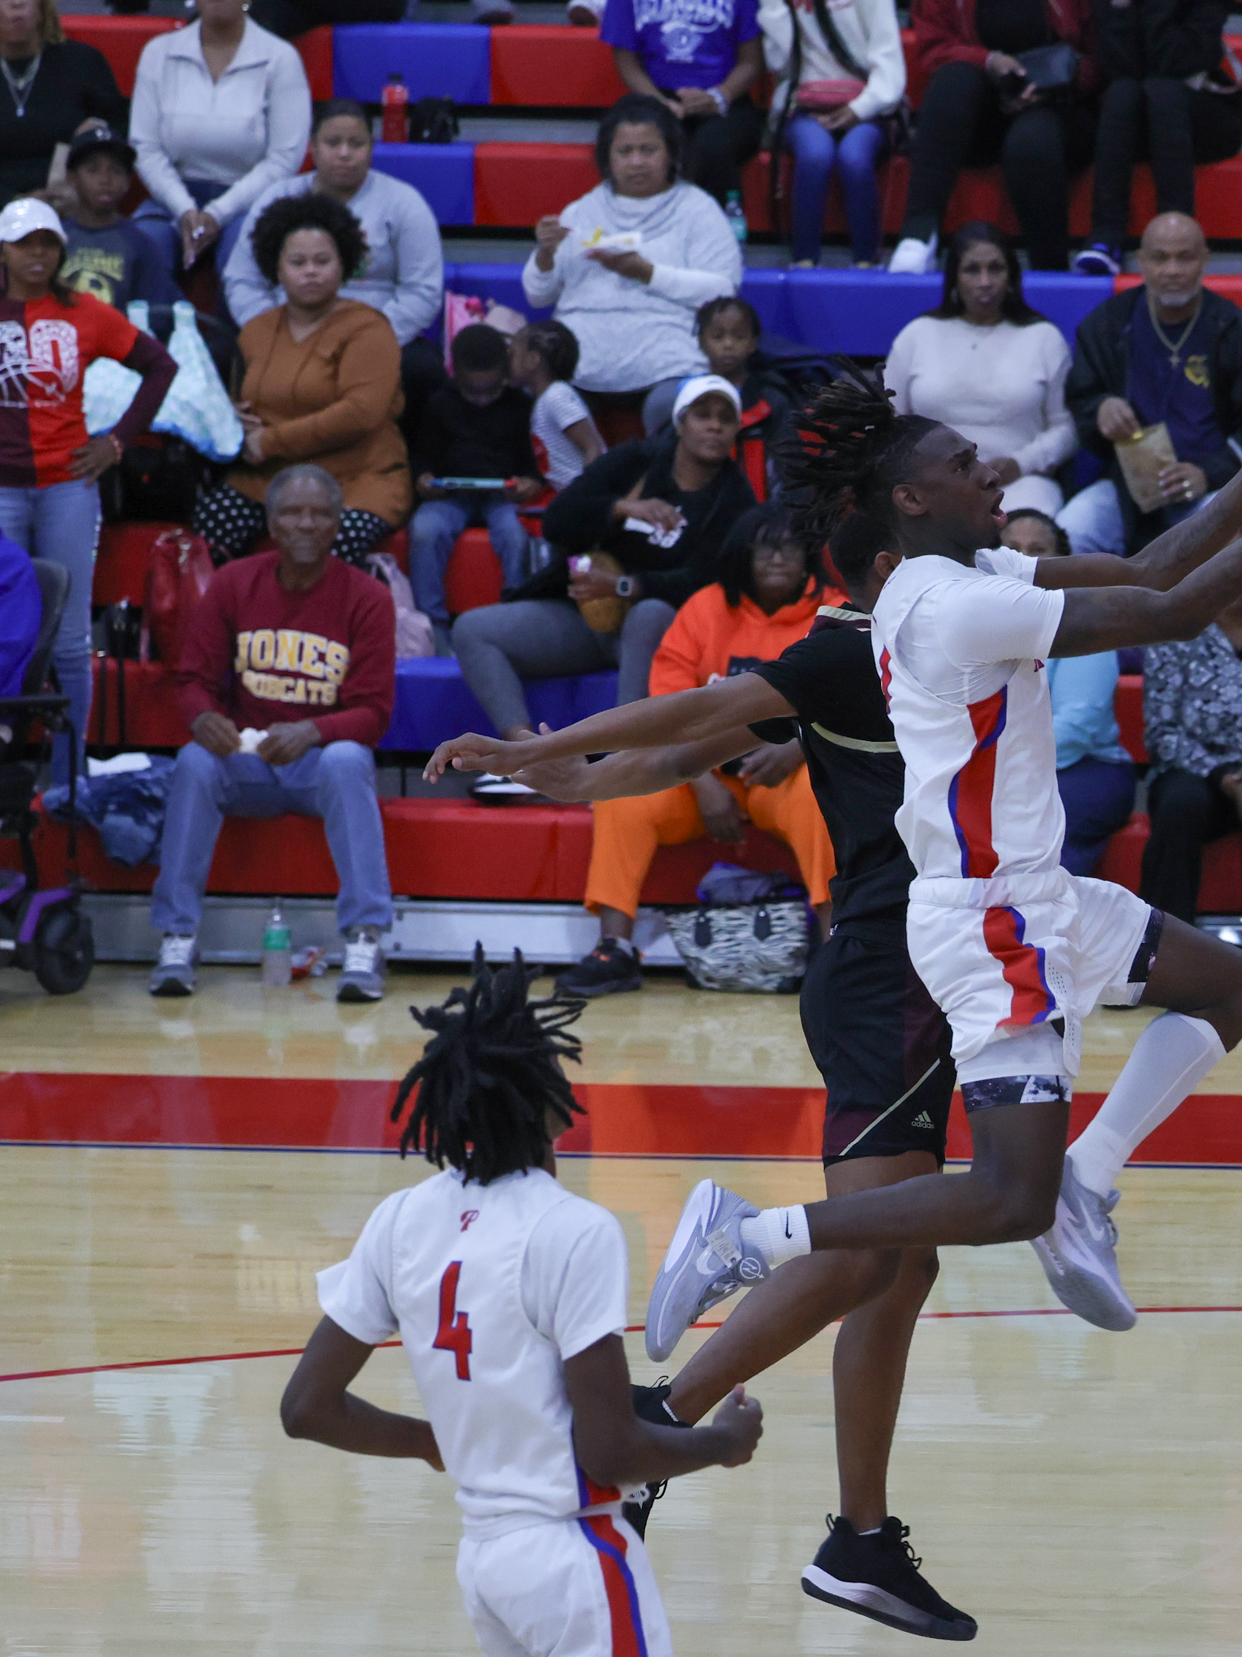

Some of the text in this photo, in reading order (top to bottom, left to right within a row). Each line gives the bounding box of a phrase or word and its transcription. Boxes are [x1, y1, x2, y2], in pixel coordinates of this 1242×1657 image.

[235, 628, 349, 686] JONES
[911, 1121, 934, 1129] adidas
[432, 1261, 472, 1381] 4
